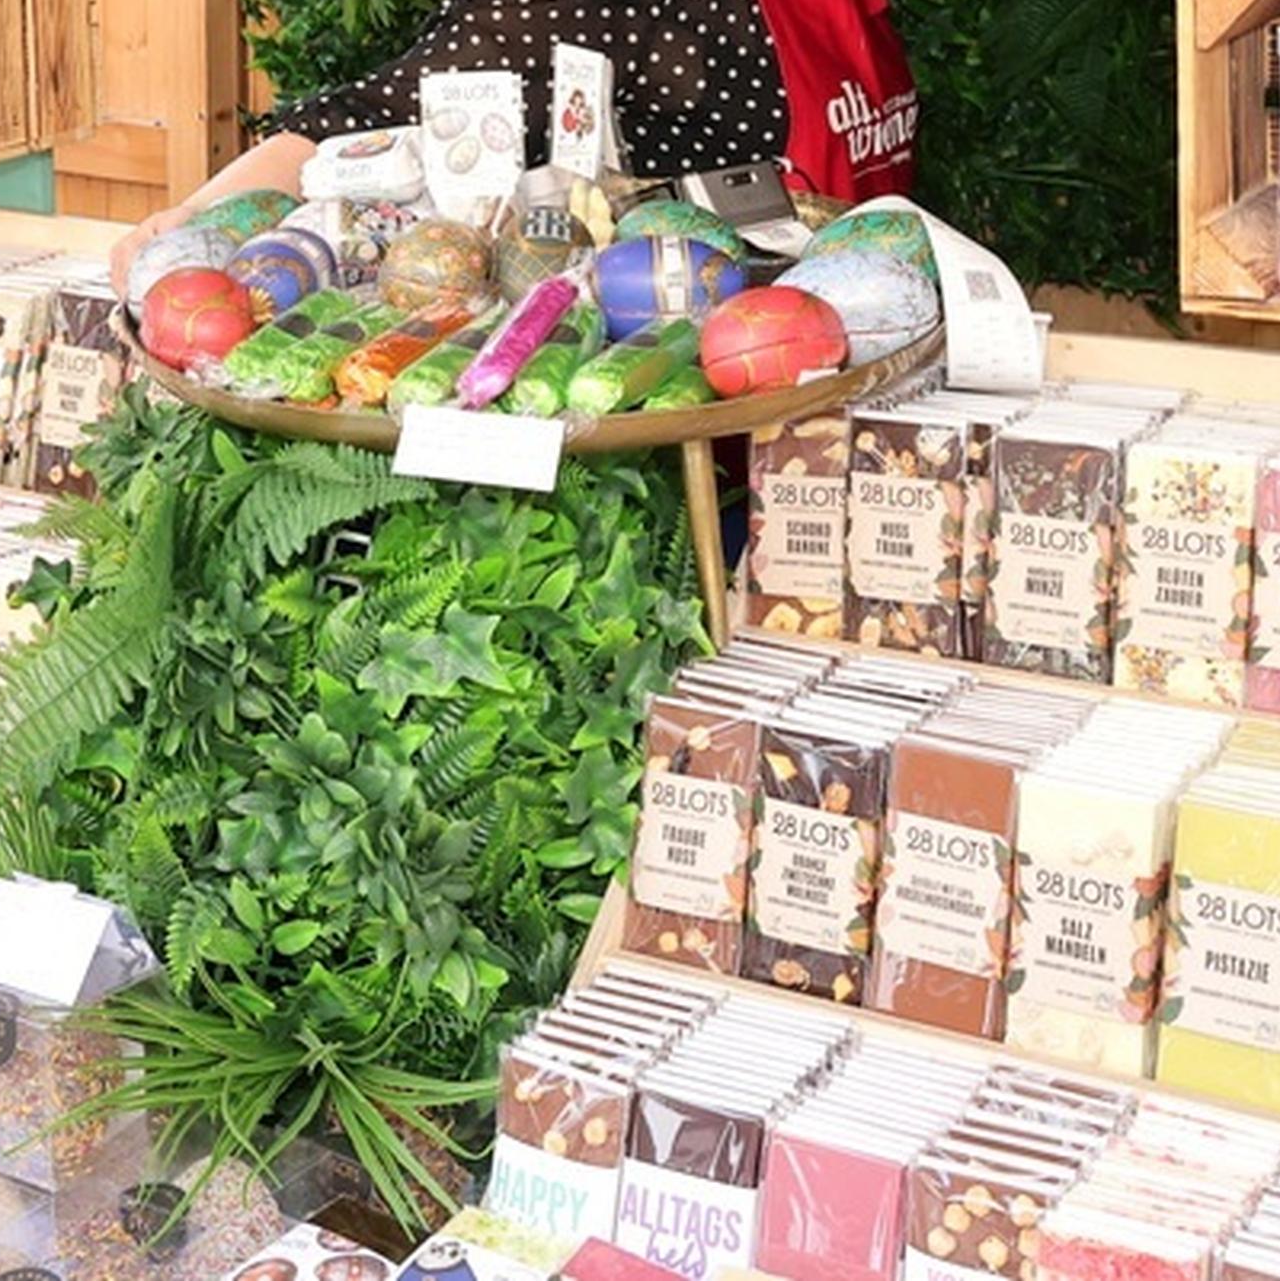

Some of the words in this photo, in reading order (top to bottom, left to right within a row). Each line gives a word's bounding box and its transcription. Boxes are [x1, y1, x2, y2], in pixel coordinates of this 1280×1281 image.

[464, 84, 499, 100] LOTS
[772, 483, 797, 503] 28
[801, 486, 847, 507] LOTS
[860, 483, 885, 503] 28
[890, 486, 934, 510] LOTS
[1010, 524, 1035, 546] 28
[1040, 526, 1088, 553] LOTS
[1143, 527, 1170, 549] 28
[1175, 531, 1225, 557] LOTS
[652, 782, 677, 806] 28
[680, 786, 728, 817] LOTS
[773, 812, 798, 837] 28
[802, 818, 850, 851] LOTS
[907, 827, 934, 853] 28
[937, 832, 991, 867] LOTS
[1036, 869, 1064, 897] 28
[1067, 878, 1124, 910] LOTS
[1196, 892, 1227, 919] 28
[1061, 917, 1094, 942] SALZ
[1045, 934, 1107, 965] MANDELN
[1205, 950, 1270, 985] PISTAZIE
[493, 1158, 589, 1233] HAPPY
[622, 1183, 742, 1253] ALLTAGS
